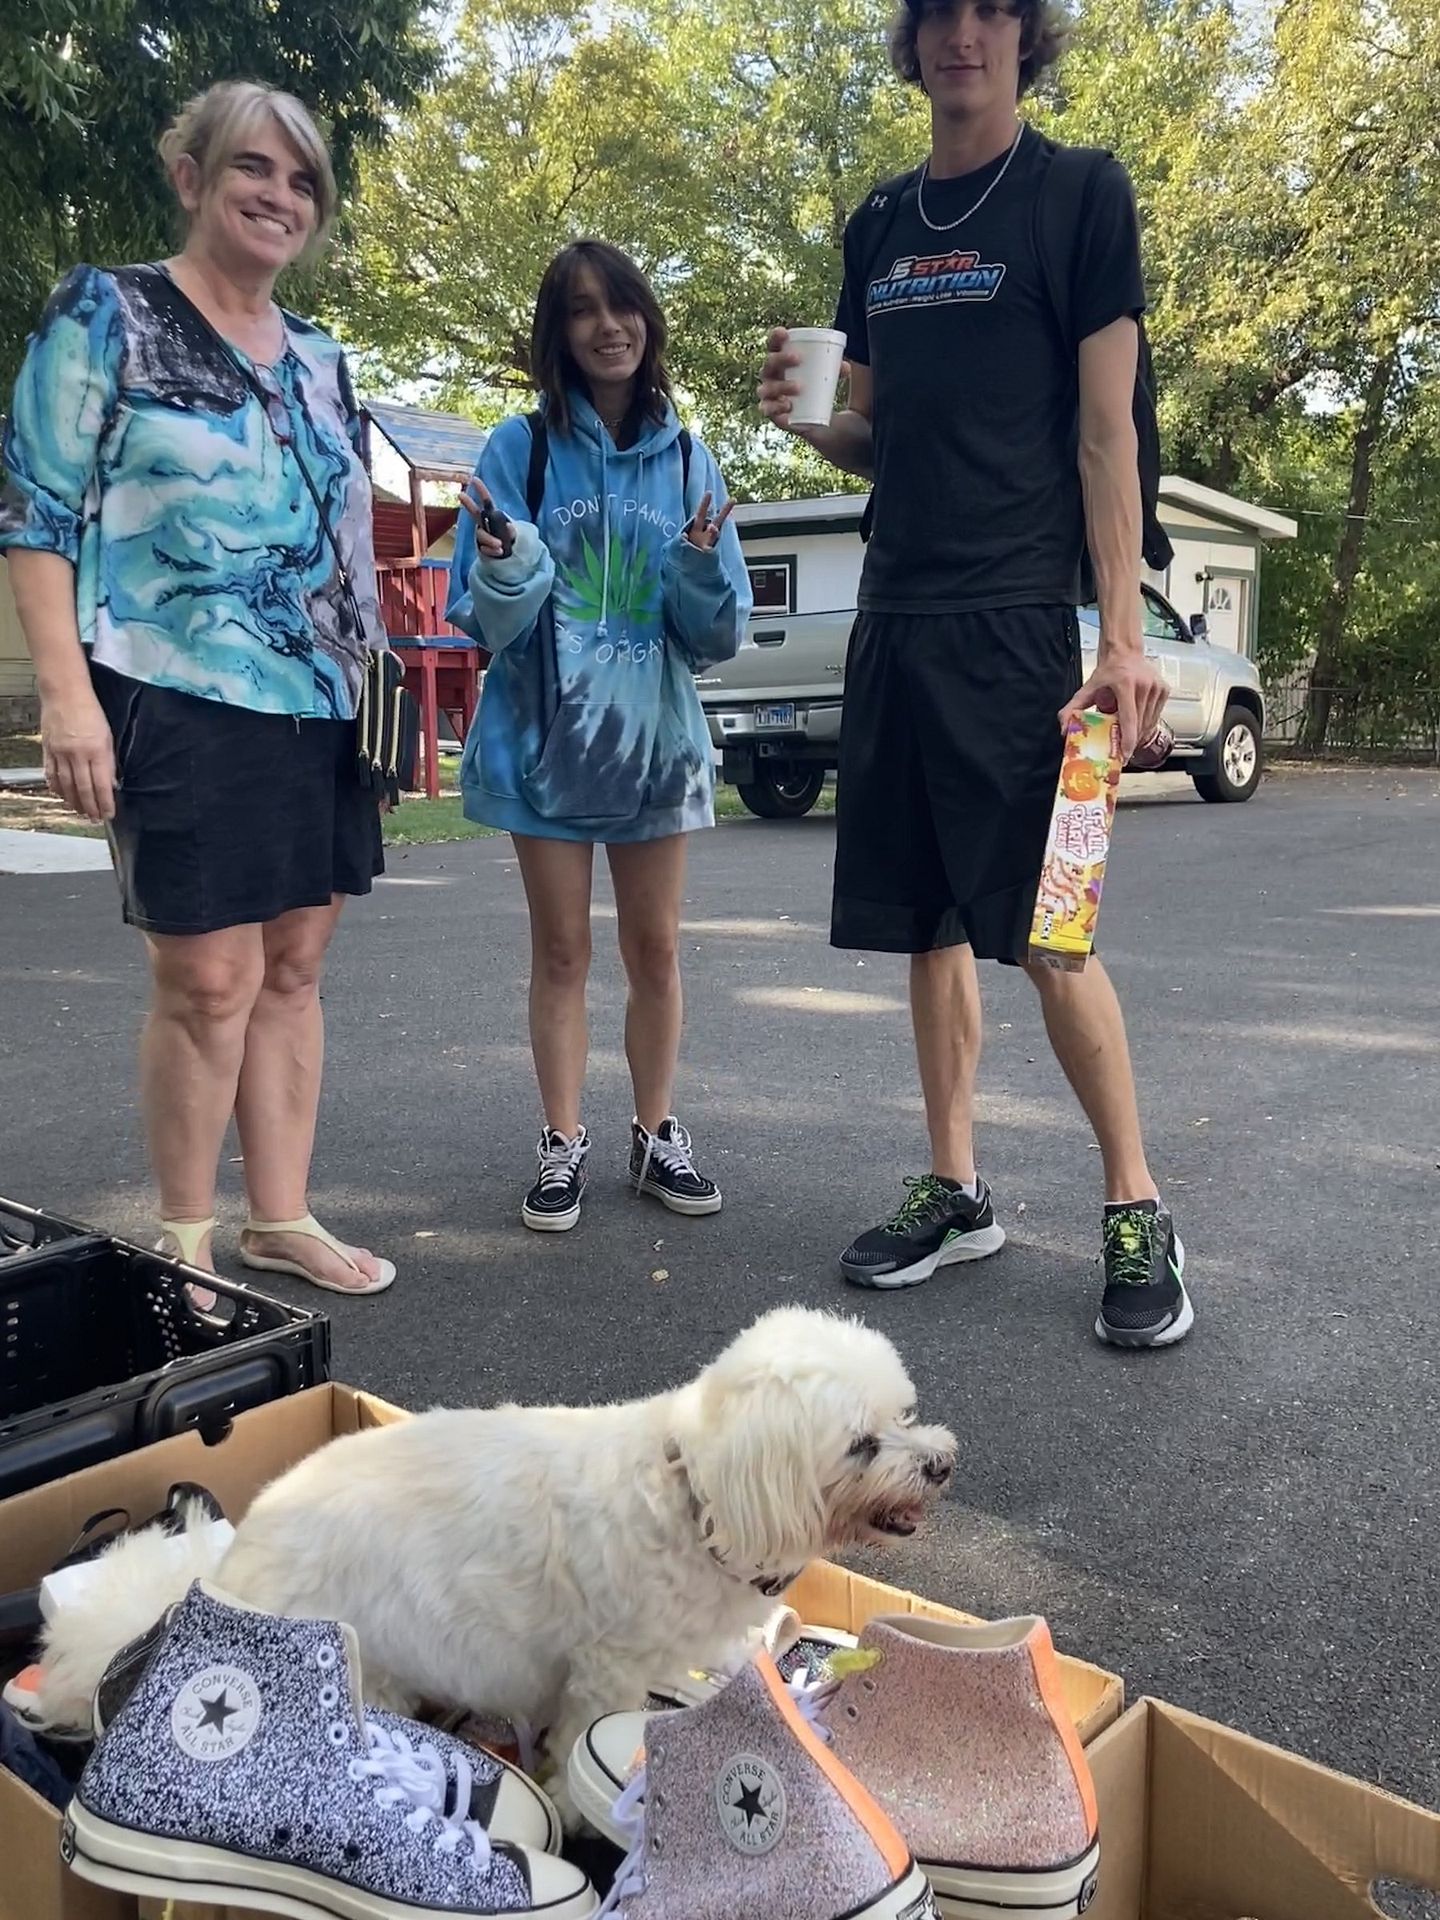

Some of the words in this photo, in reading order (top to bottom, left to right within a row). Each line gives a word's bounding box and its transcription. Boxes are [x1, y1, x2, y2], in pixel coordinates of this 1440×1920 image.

[870, 269, 1000, 301] NUTRITION
[891, 260, 912, 281] 5
[912, 253, 976, 276] STAR
[623, 499, 677, 538] PANIC
[1067, 804, 1088, 859] PARTY
[1086, 808, 1107, 854] FALL
[1041, 912, 1054, 939] PACK
[192, 1673, 253, 1709] CONVERSE
[181, 1725, 198, 1747] ALL
[200, 1736, 235, 1753] STAR
[722, 1762, 766, 1806] CONVERSE
[739, 1831, 758, 1846] ALL
[760, 1810, 779, 1844] STAR
